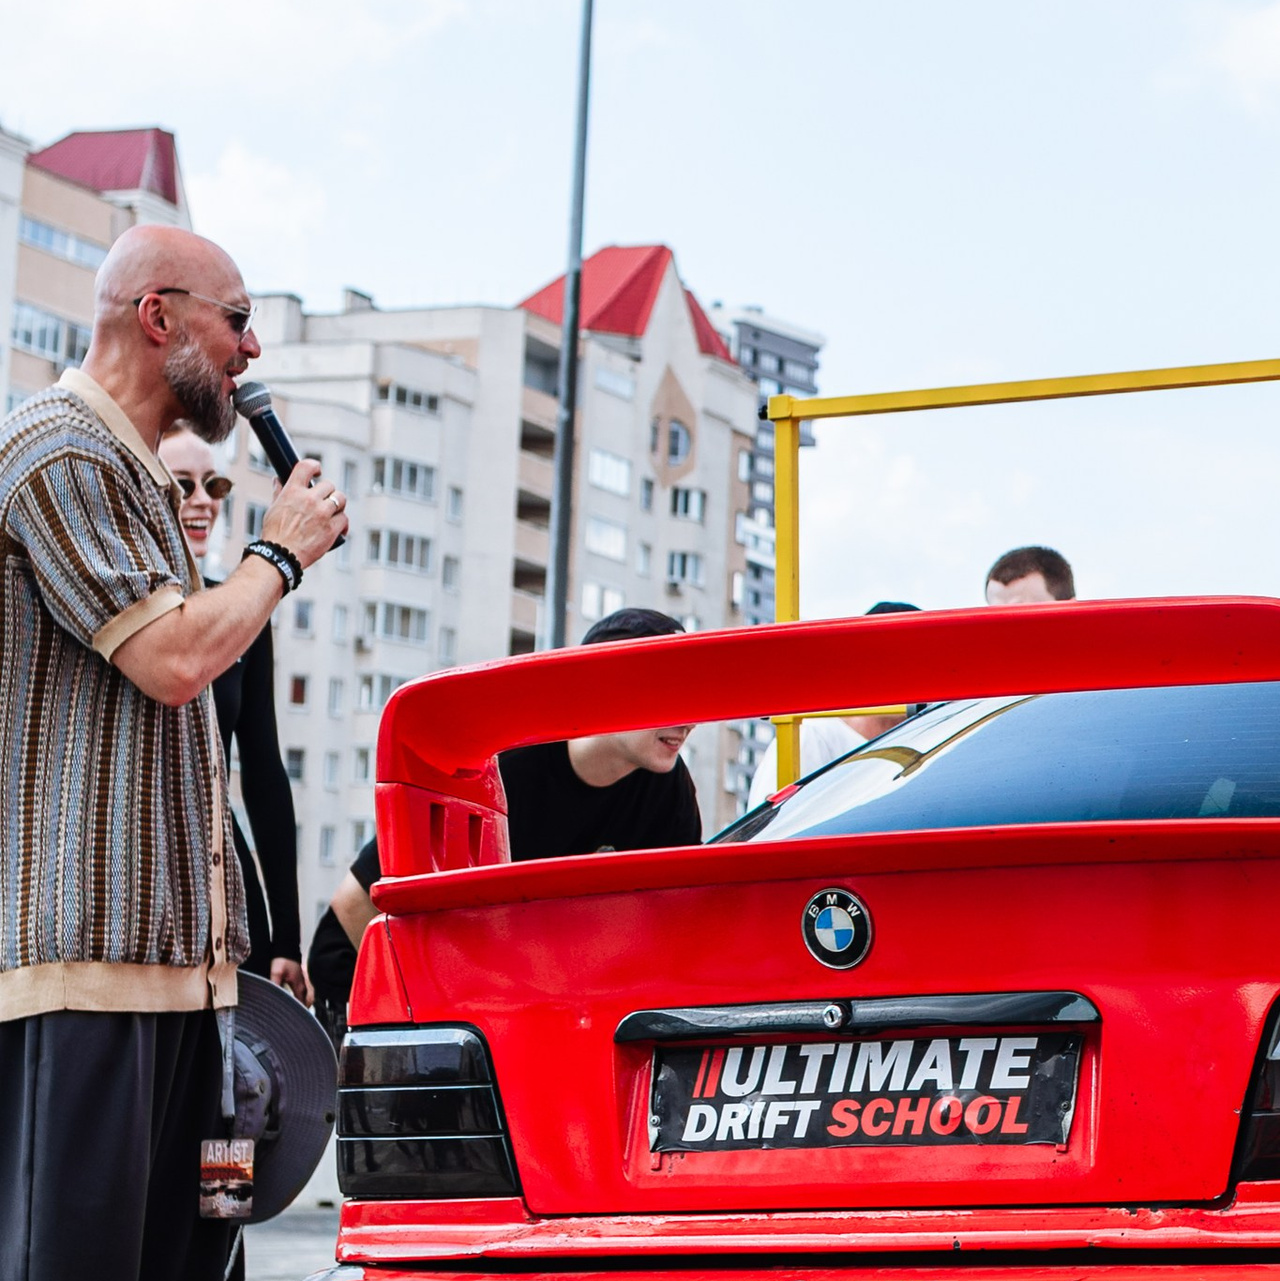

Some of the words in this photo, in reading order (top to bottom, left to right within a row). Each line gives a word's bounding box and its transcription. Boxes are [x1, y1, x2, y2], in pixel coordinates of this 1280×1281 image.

[808, 893, 861, 919] BMW
[681, 1100, 821, 1142] DRIFT
[827, 1095, 1029, 1138] SCHOOL
[207, 1142, 248, 1163] ARTIST
